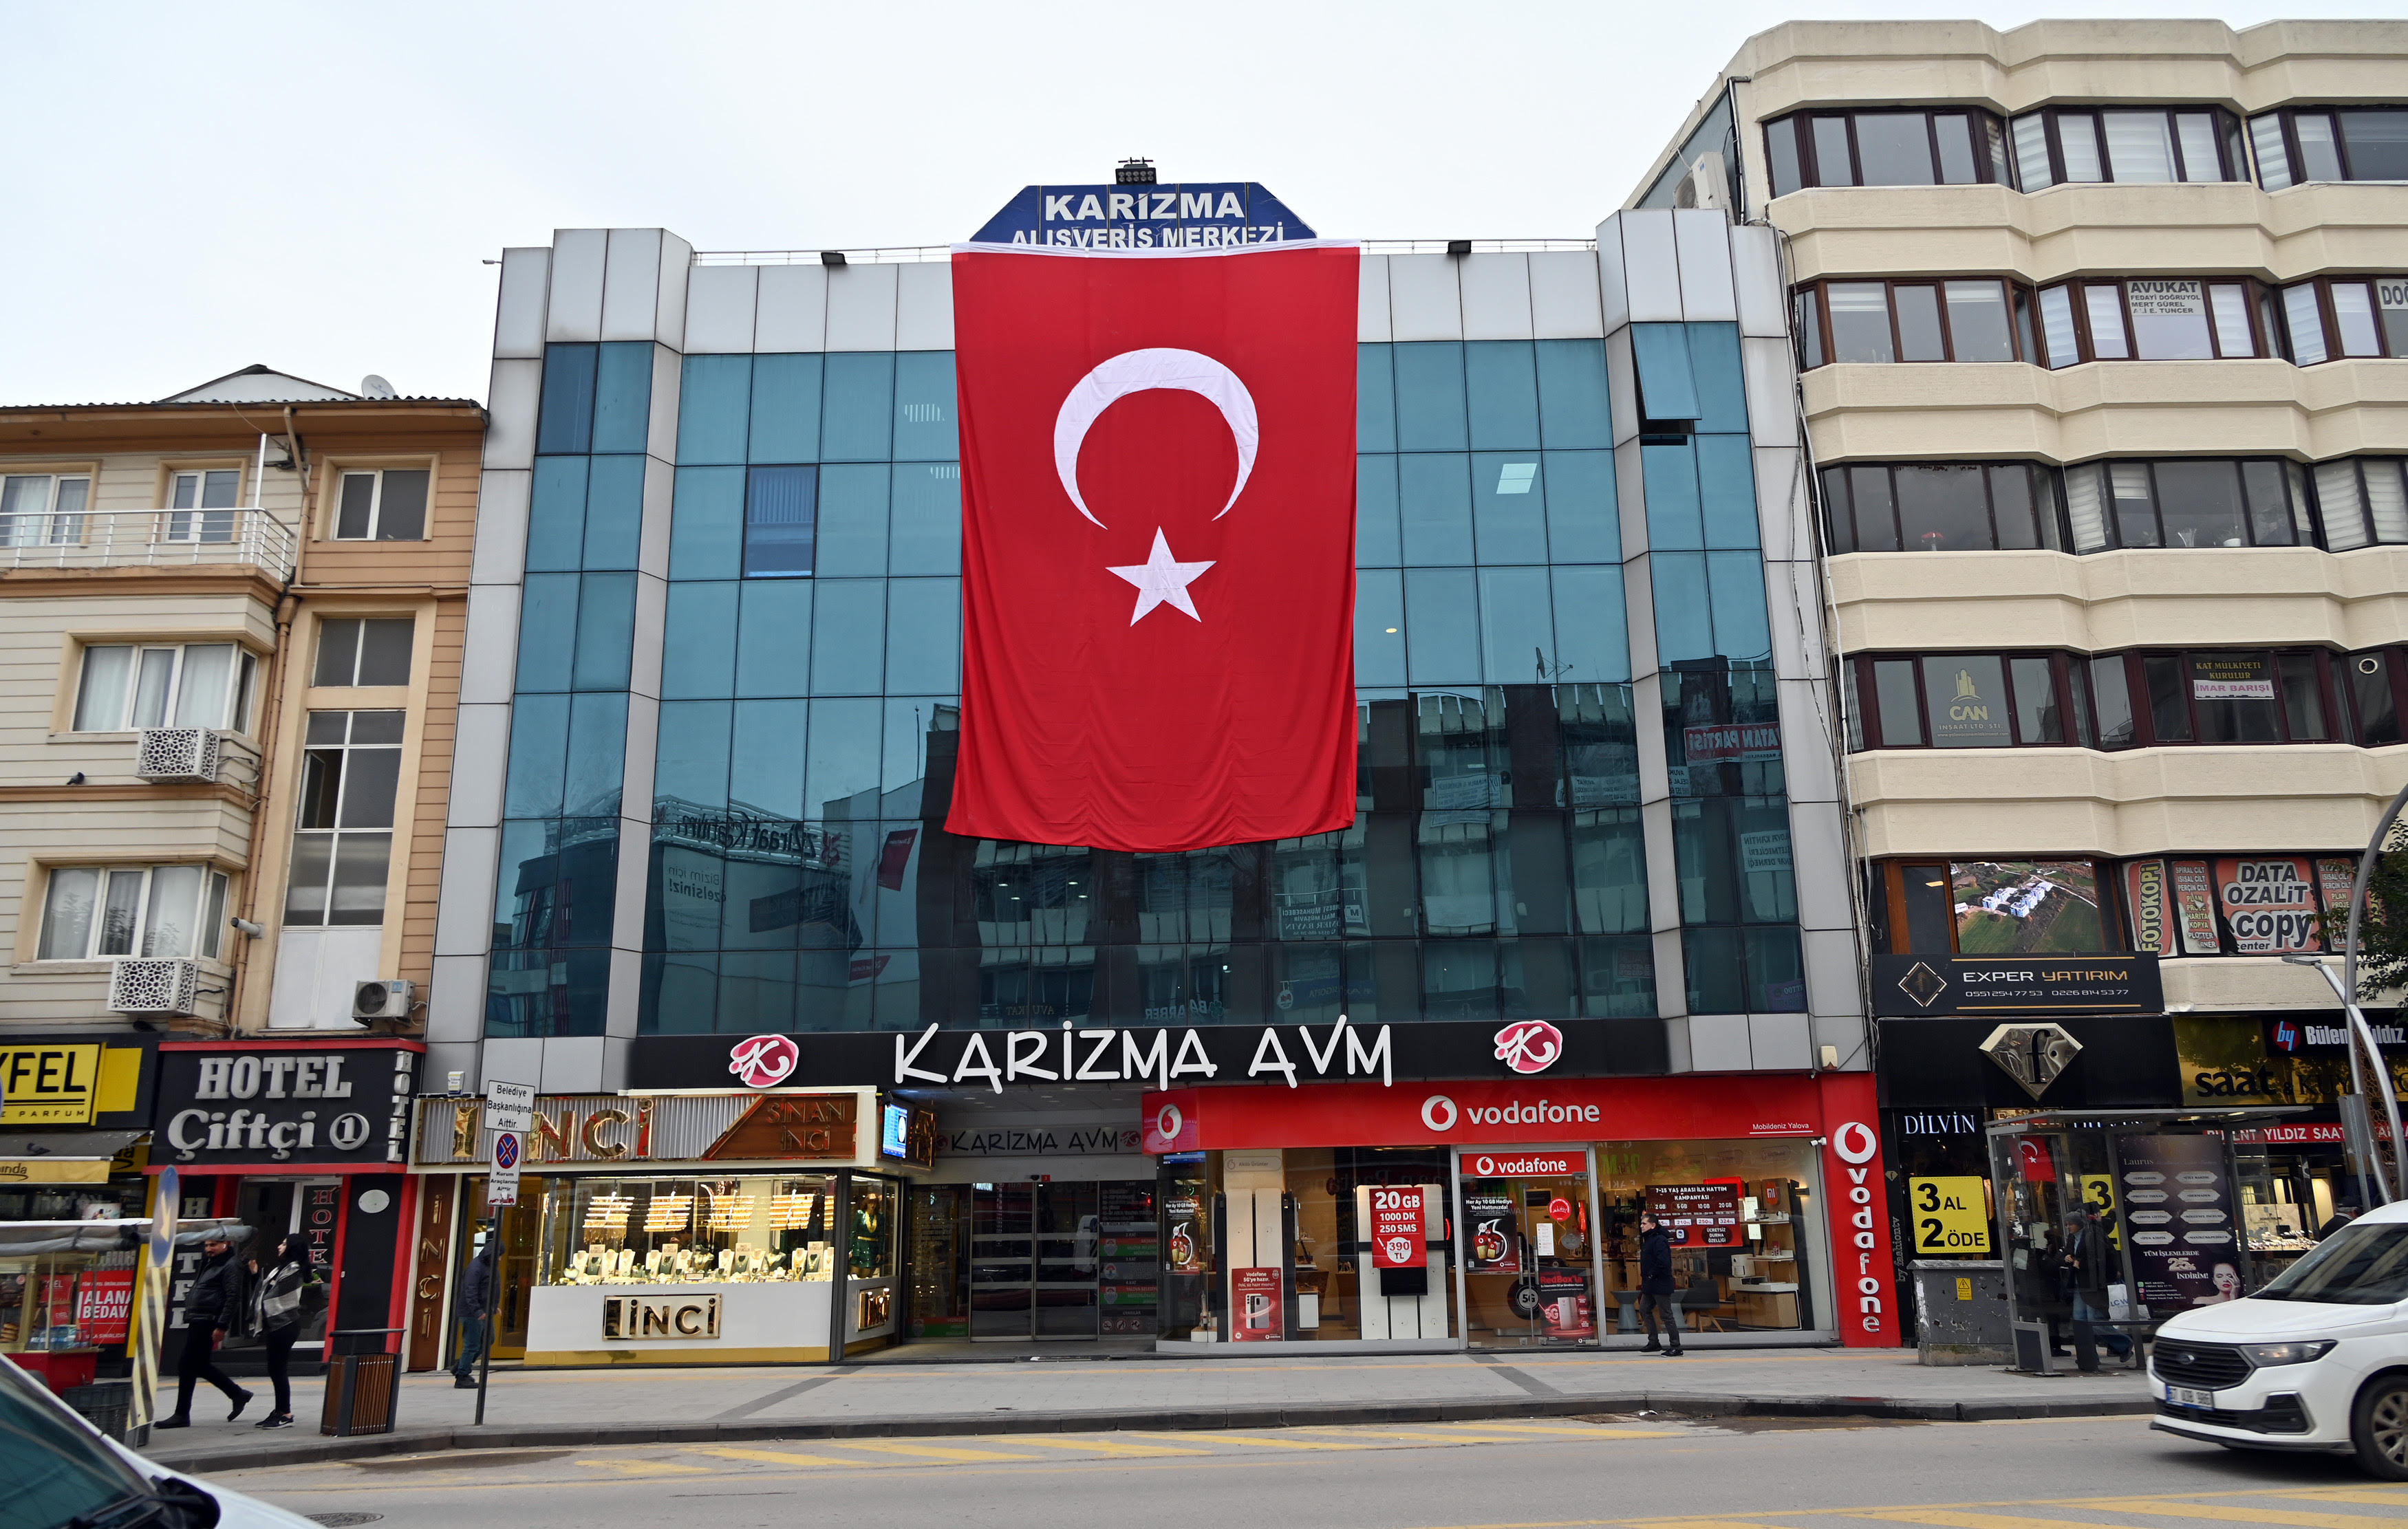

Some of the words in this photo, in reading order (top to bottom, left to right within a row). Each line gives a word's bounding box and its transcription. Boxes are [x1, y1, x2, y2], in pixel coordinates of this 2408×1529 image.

[2131, 282, 2197, 293] AVUKAT
[2195, 683, 2226, 692] İMAR
[2230, 684, 2270, 693] BARIŞI
[1949, 705, 1988, 721] CAN
[2242, 865, 2297, 883] DATA
[2235, 913, 2312, 948] copy
[1963, 972, 2034, 982] EXPER
[2041, 970, 2129, 982] YATIRIM
[2305, 1026, 2347, 1045] Bülen
[896, 1021, 1218, 1094] KARİZMA
[1247, 1014, 1393, 1089] AVM
[195, 1056, 353, 1100] HOTEL
[2194, 1065, 2277, 1098] saat
[497, 1085, 528, 1098] Belediye
[386, 1050, 413, 1162] HOTEL
[487, 1100, 532, 1115] Başkanlığına
[1466, 1099, 1600, 1125] vodafone
[528, 1098, 654, 1160] NCİ
[1904, 1111, 1976, 1135] DİLVİN
[168, 1109, 317, 1161] Çiftçi
[780, 1125, 831, 1151] İNCİ
[951, 1130, 1058, 1153] KARİZMA
[1068, 1128, 1118, 1153] AVM
[2264, 1128, 2307, 1141] YILDIZ
[1498, 1157, 1567, 1175] vodafone
[1375, 1191, 1401, 1209] 20
[1403, 1195, 1421, 1208] GB
[1917, 1183, 1941, 1213] 3
[1944, 1197, 1967, 1211] AL
[2088, 1180, 2112, 1210] 3
[1379, 1213, 1401, 1221] 1000
[1403, 1212, 1416, 1220] DK
[1379, 1224, 1396, 1233] 250
[1397, 1224, 1417, 1233] SMS
[1920, 1218, 1946, 1247] 2
[1947, 1230, 1986, 1247] ÖDE
[1389, 1242, 1410, 1250] 390
[1846, 1167, 1882, 1334] vodafone
[1522, 1294, 1536, 1303] 5G
[83, 1305, 129, 1319] BEDAV
[629, 1297, 716, 1335] İNCİ
[1545, 1308, 1558, 1319] 5G
